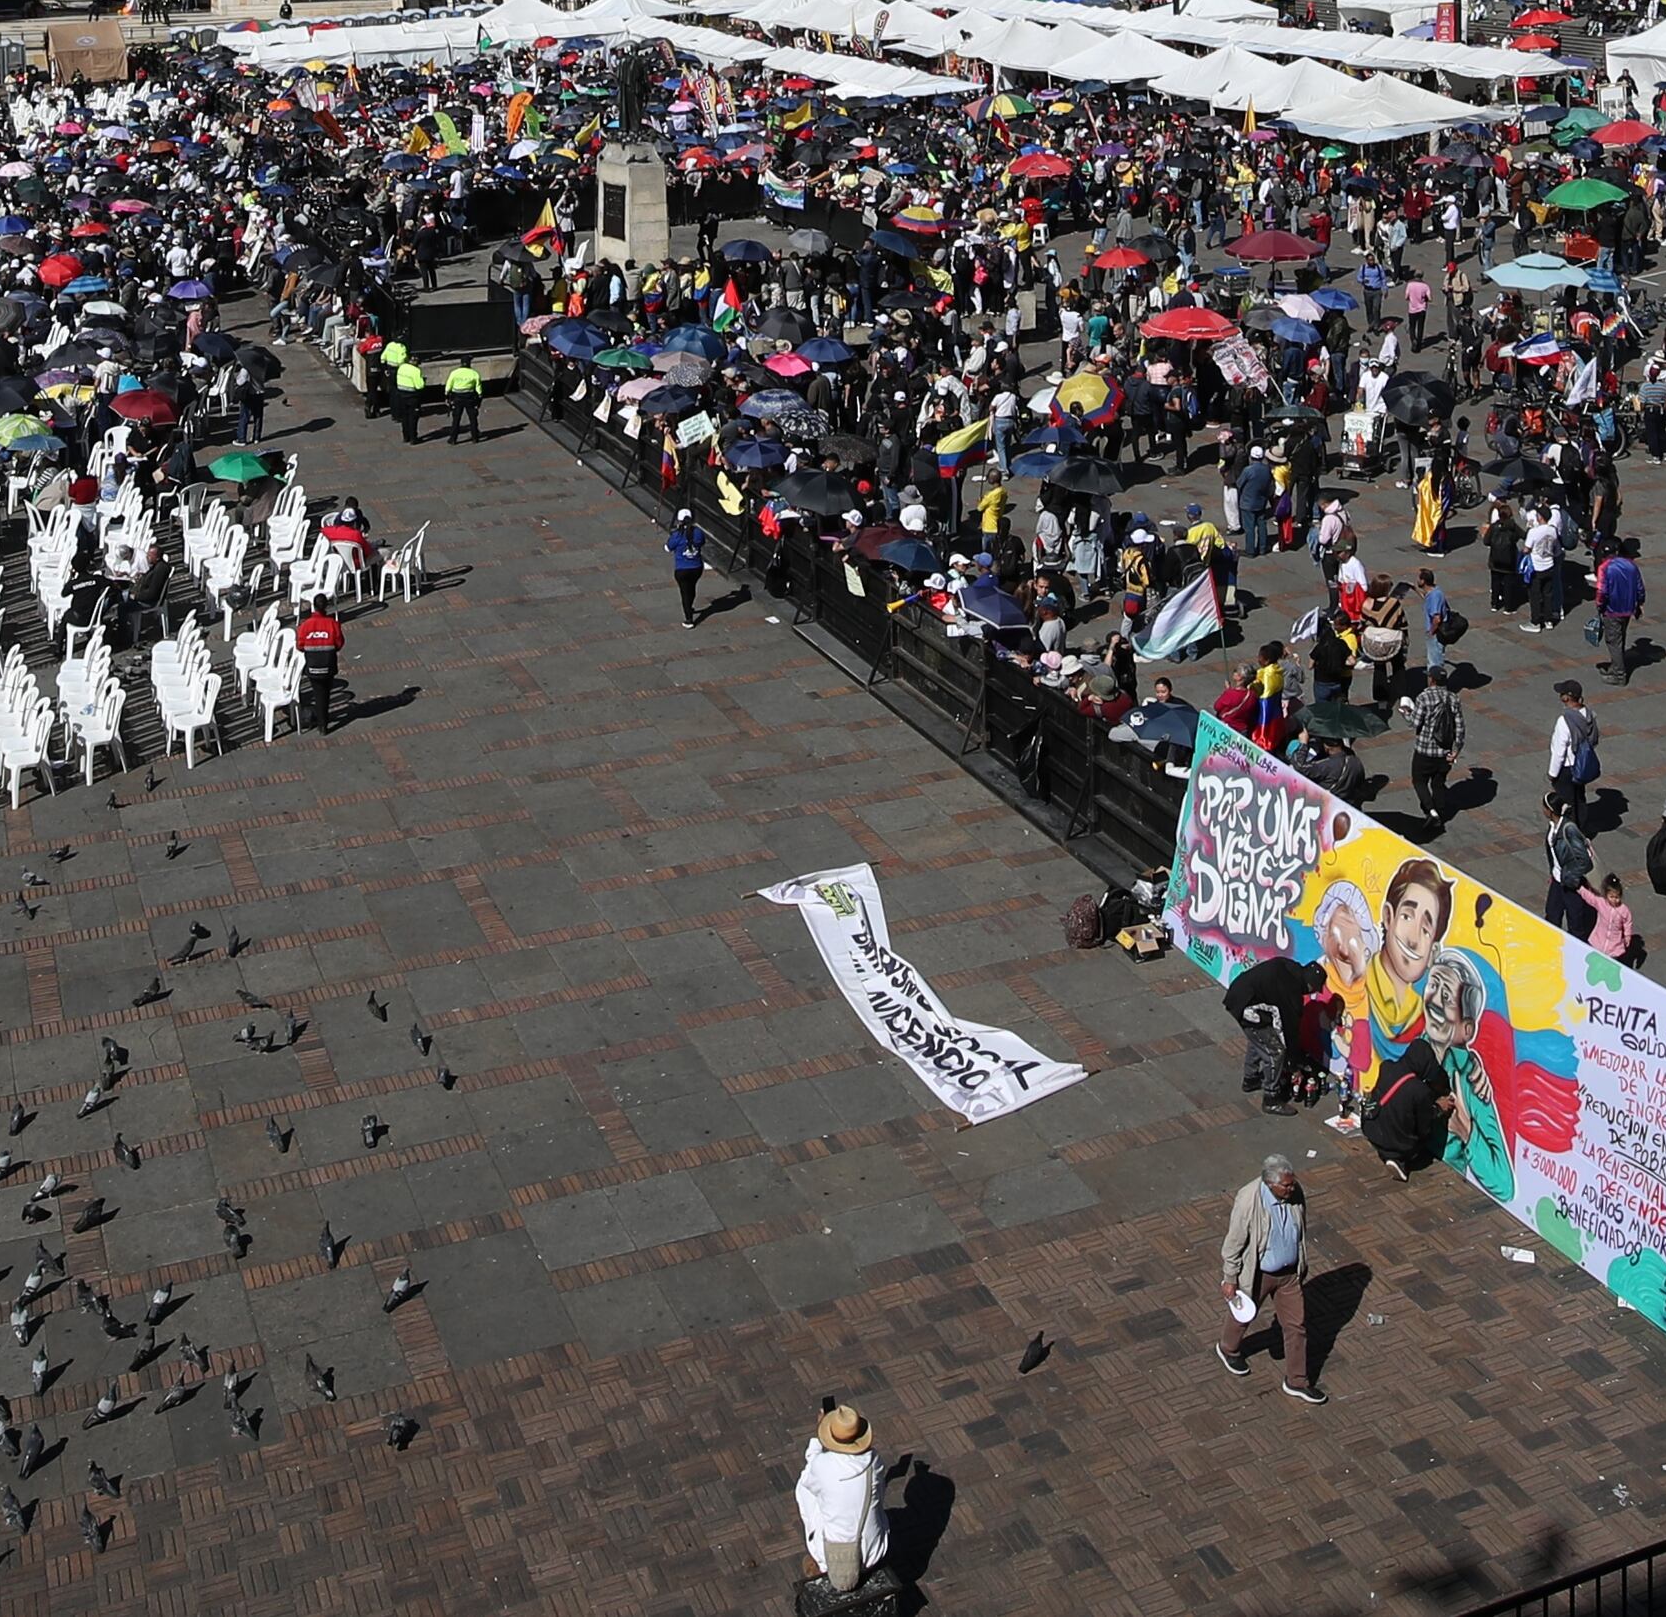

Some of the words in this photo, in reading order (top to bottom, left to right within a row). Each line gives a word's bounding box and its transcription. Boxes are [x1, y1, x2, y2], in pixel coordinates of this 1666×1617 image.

[1219, 732, 1255, 762] COLOMBIA
[1198, 772, 1254, 833] POR
[1257, 786, 1321, 864] UNA
[1209, 821, 1303, 904] VEJEZ
[1618, 1075, 1638, 1096] DE
[1606, 1127, 1628, 1150] DE
